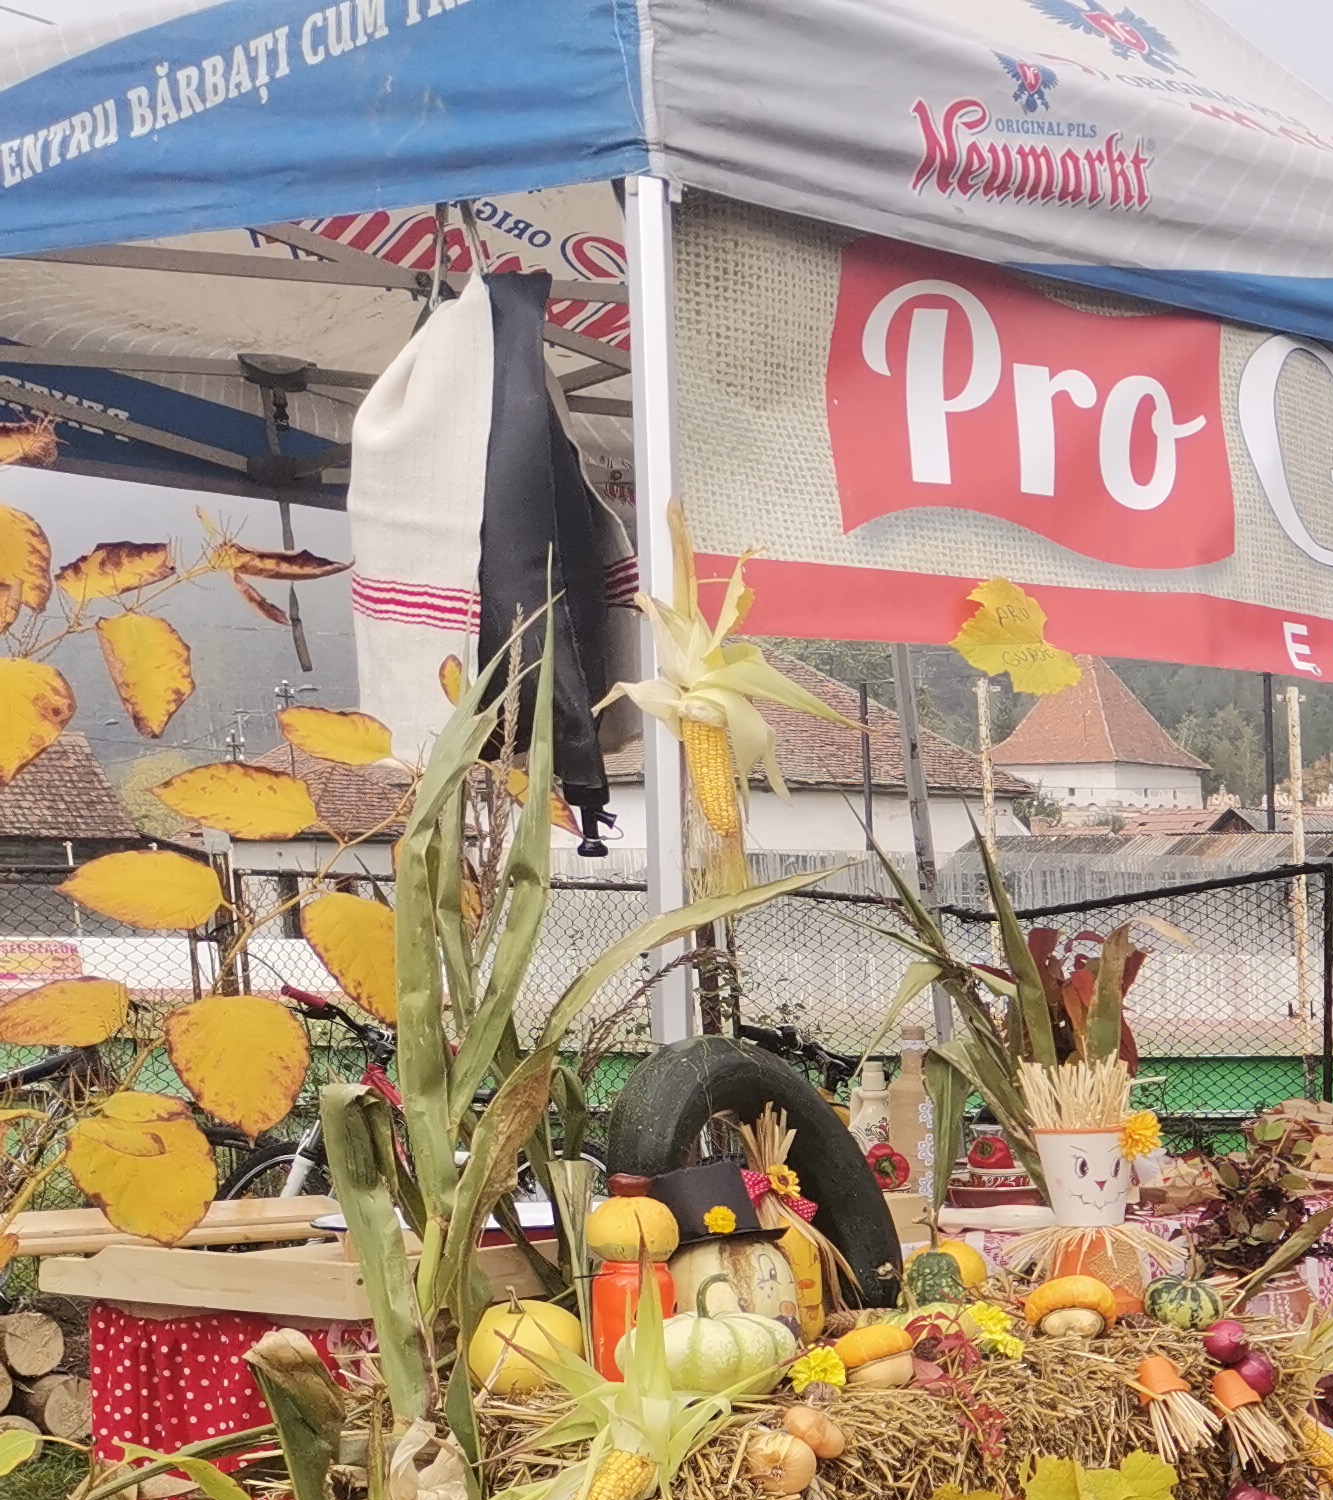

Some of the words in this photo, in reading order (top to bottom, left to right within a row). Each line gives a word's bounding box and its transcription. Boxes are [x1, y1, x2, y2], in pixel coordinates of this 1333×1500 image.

[909, 96, 1154, 212] Neumarkt
[995, 118, 1065, 136] ORIGINAL
[1067, 122, 1097, 138] PILS
[862, 279, 1207, 510] Pro
